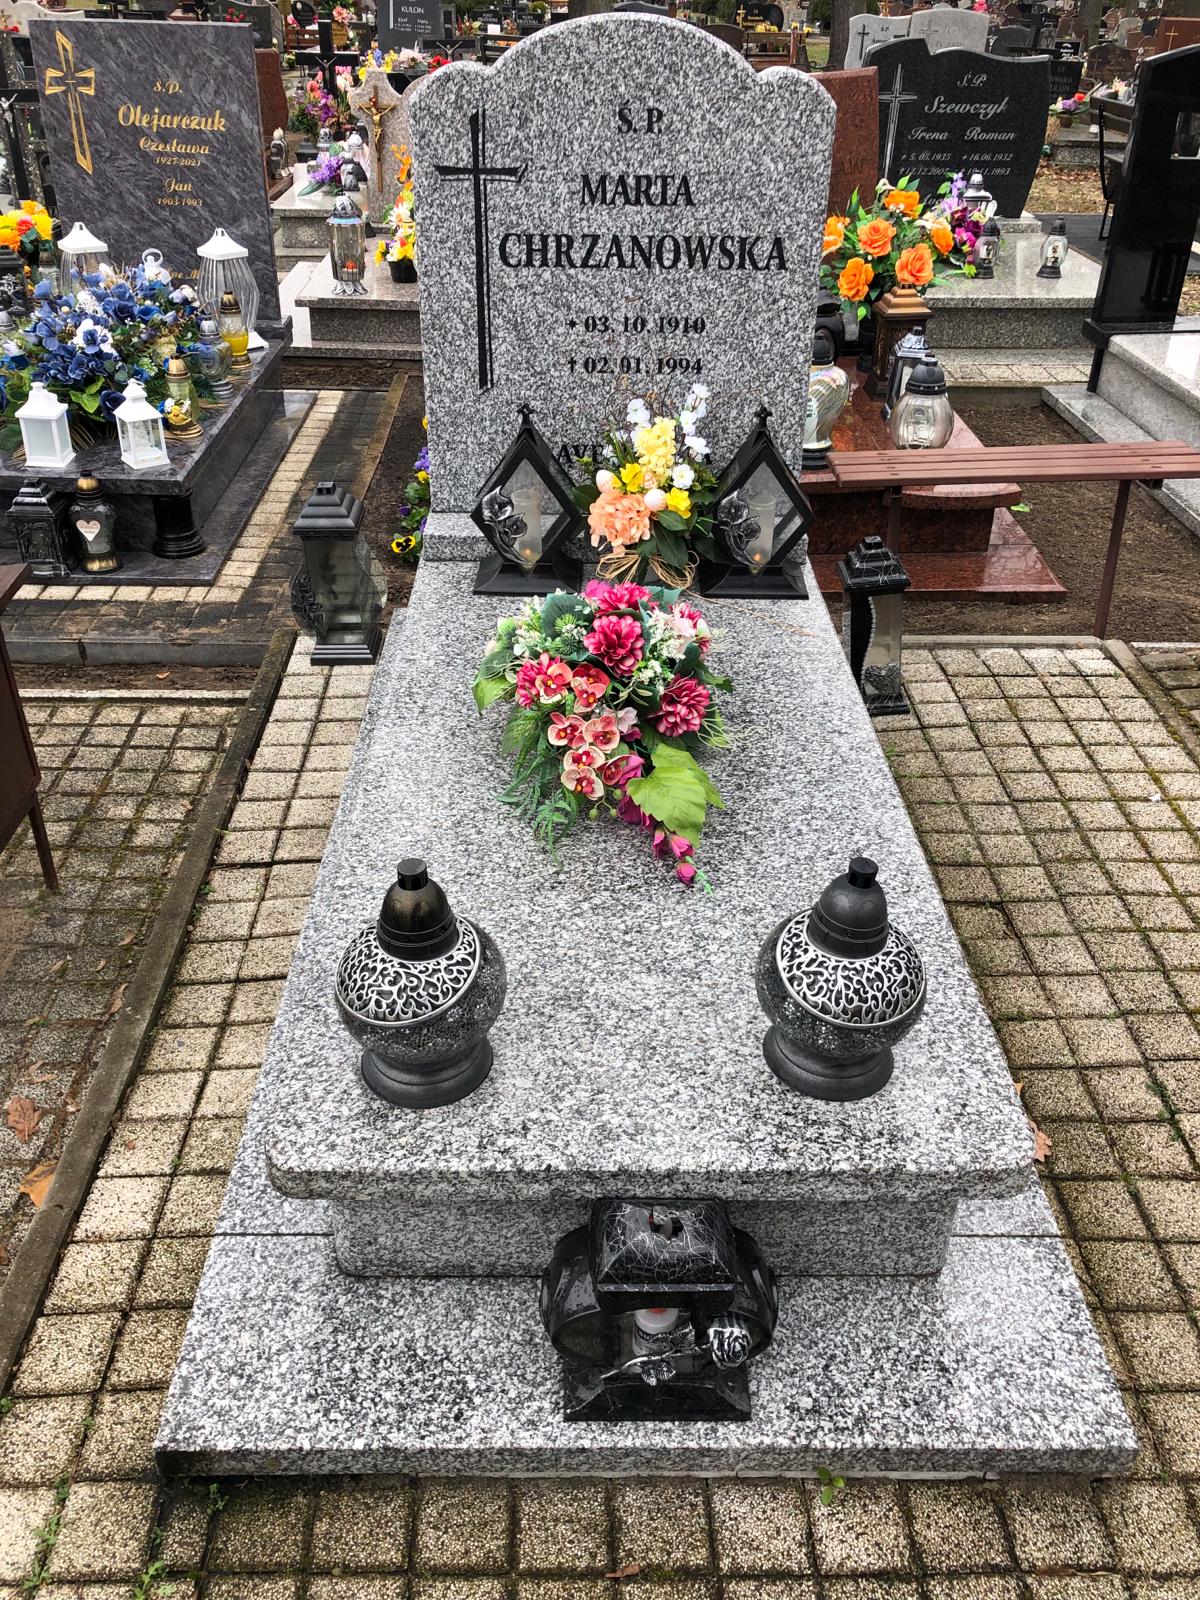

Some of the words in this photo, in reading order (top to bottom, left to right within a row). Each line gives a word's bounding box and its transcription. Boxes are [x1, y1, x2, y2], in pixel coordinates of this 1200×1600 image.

[118, 103, 226, 133] Olejarczuk
[924, 95, 1010, 120] Szewczyk
[139, 136, 210, 155] Czesława
[908, 126, 951, 141] Irena
[964, 126, 1017, 141] Roman
[164, 178, 193, 193] Jan
[580, 173, 697, 207] MARTA
[499, 232, 789, 272] CHRZANOWSKA
